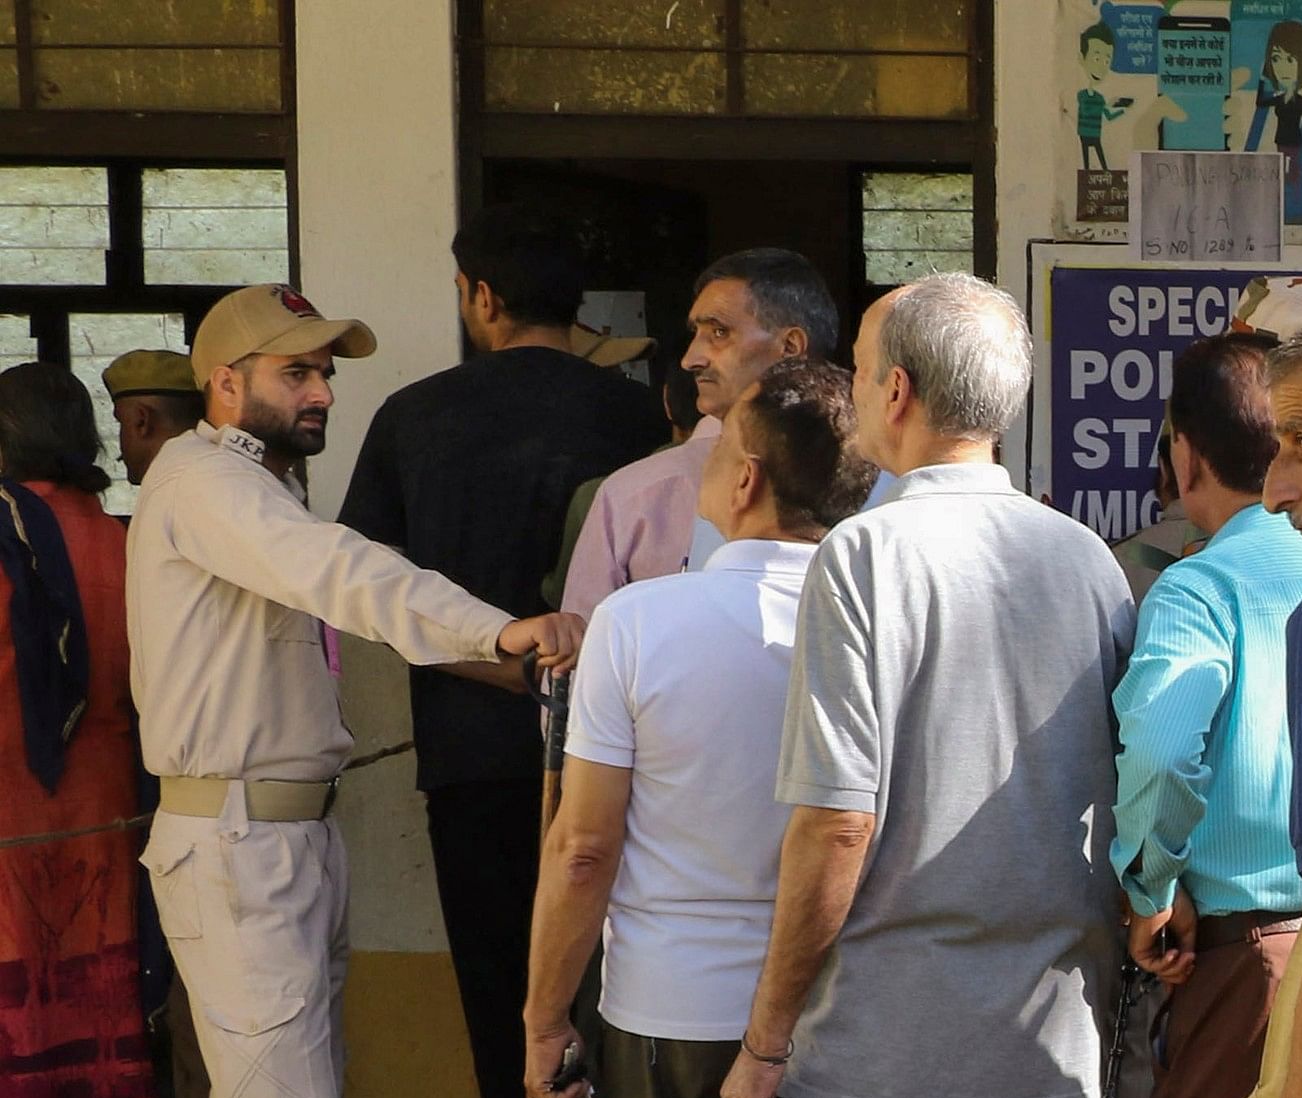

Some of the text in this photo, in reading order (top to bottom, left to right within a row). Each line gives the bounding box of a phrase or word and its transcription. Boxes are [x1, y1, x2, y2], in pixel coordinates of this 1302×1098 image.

[1108, 284, 1241, 337] SPECI
[229, 434, 264, 456] JKP
[1070, 488, 1164, 542] (MIG
